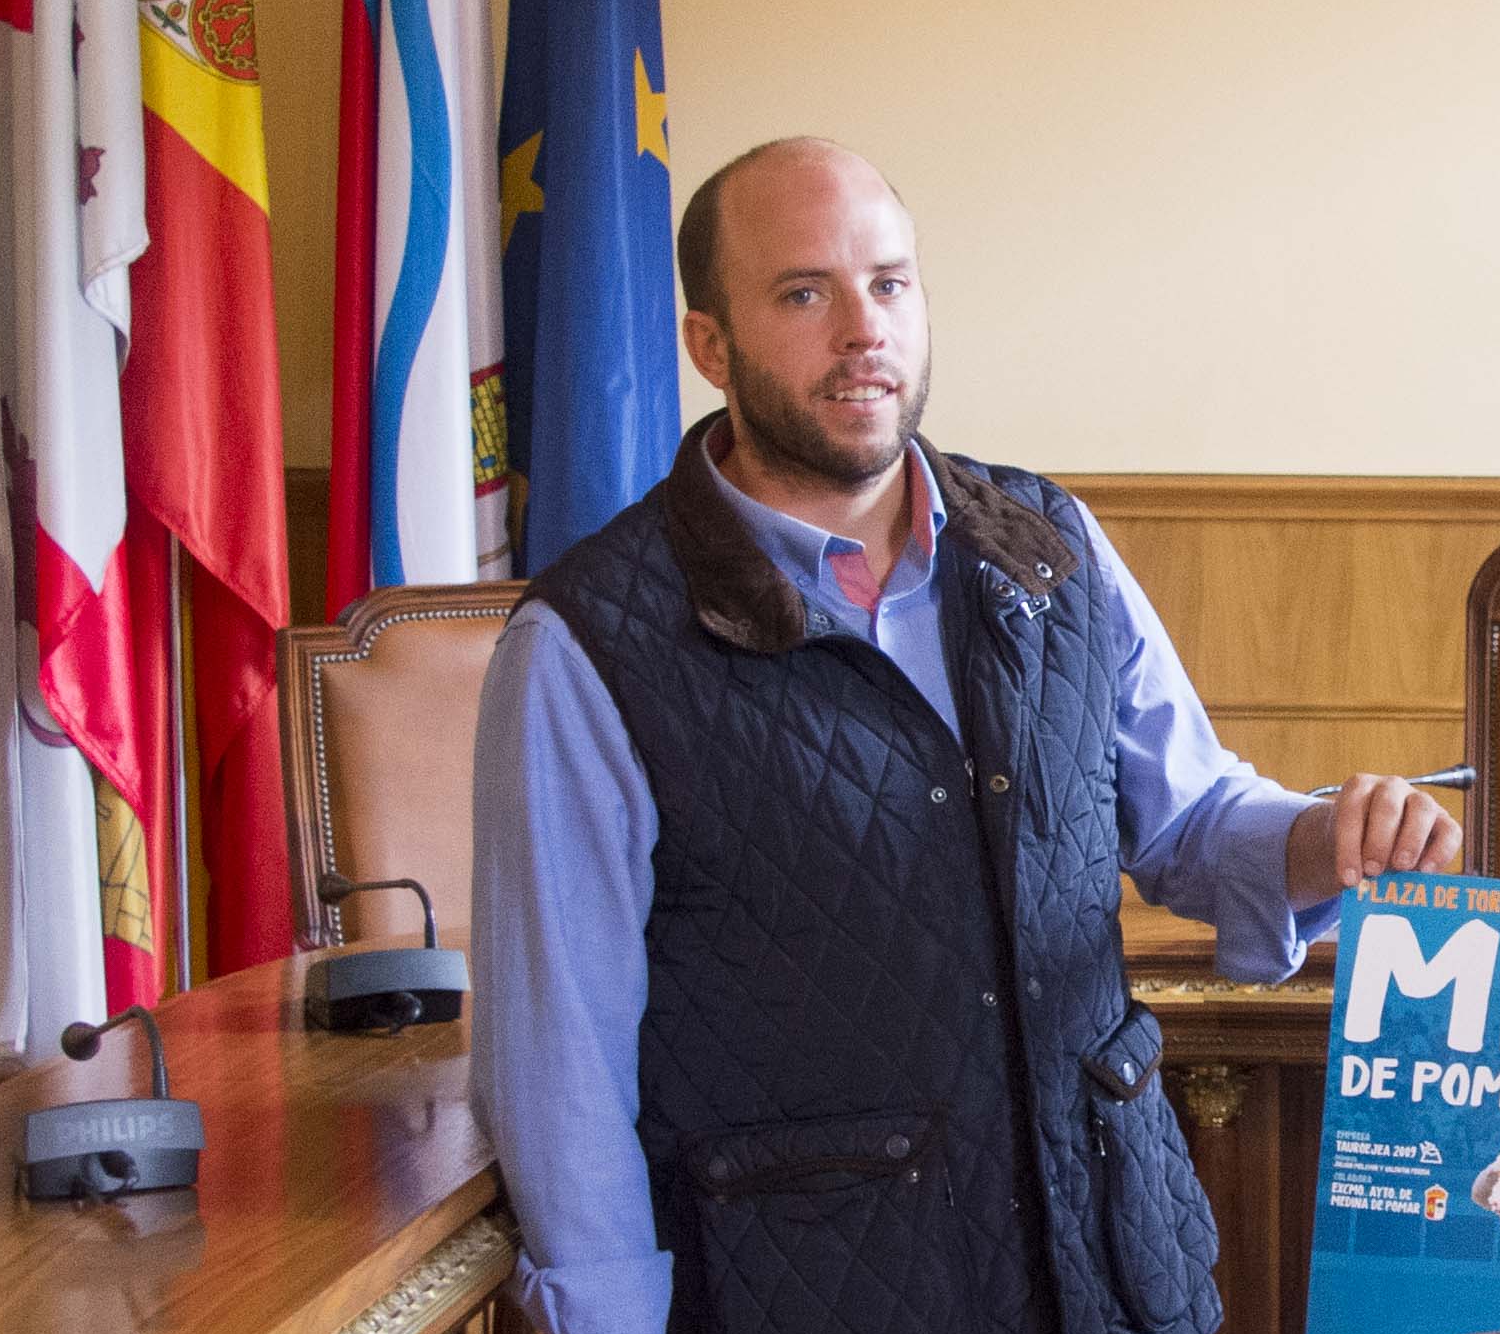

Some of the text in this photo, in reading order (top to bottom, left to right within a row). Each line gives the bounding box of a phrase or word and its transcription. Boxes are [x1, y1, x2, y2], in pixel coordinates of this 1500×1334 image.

[1357, 879, 1428, 908] PLAZA
[1434, 885, 1458, 910] DE
[1341, 1055, 1398, 1098] DE
[58, 1110, 175, 1148] PHILIPS
[1330, 1195, 1420, 1214] MEDINA DE POMAR
